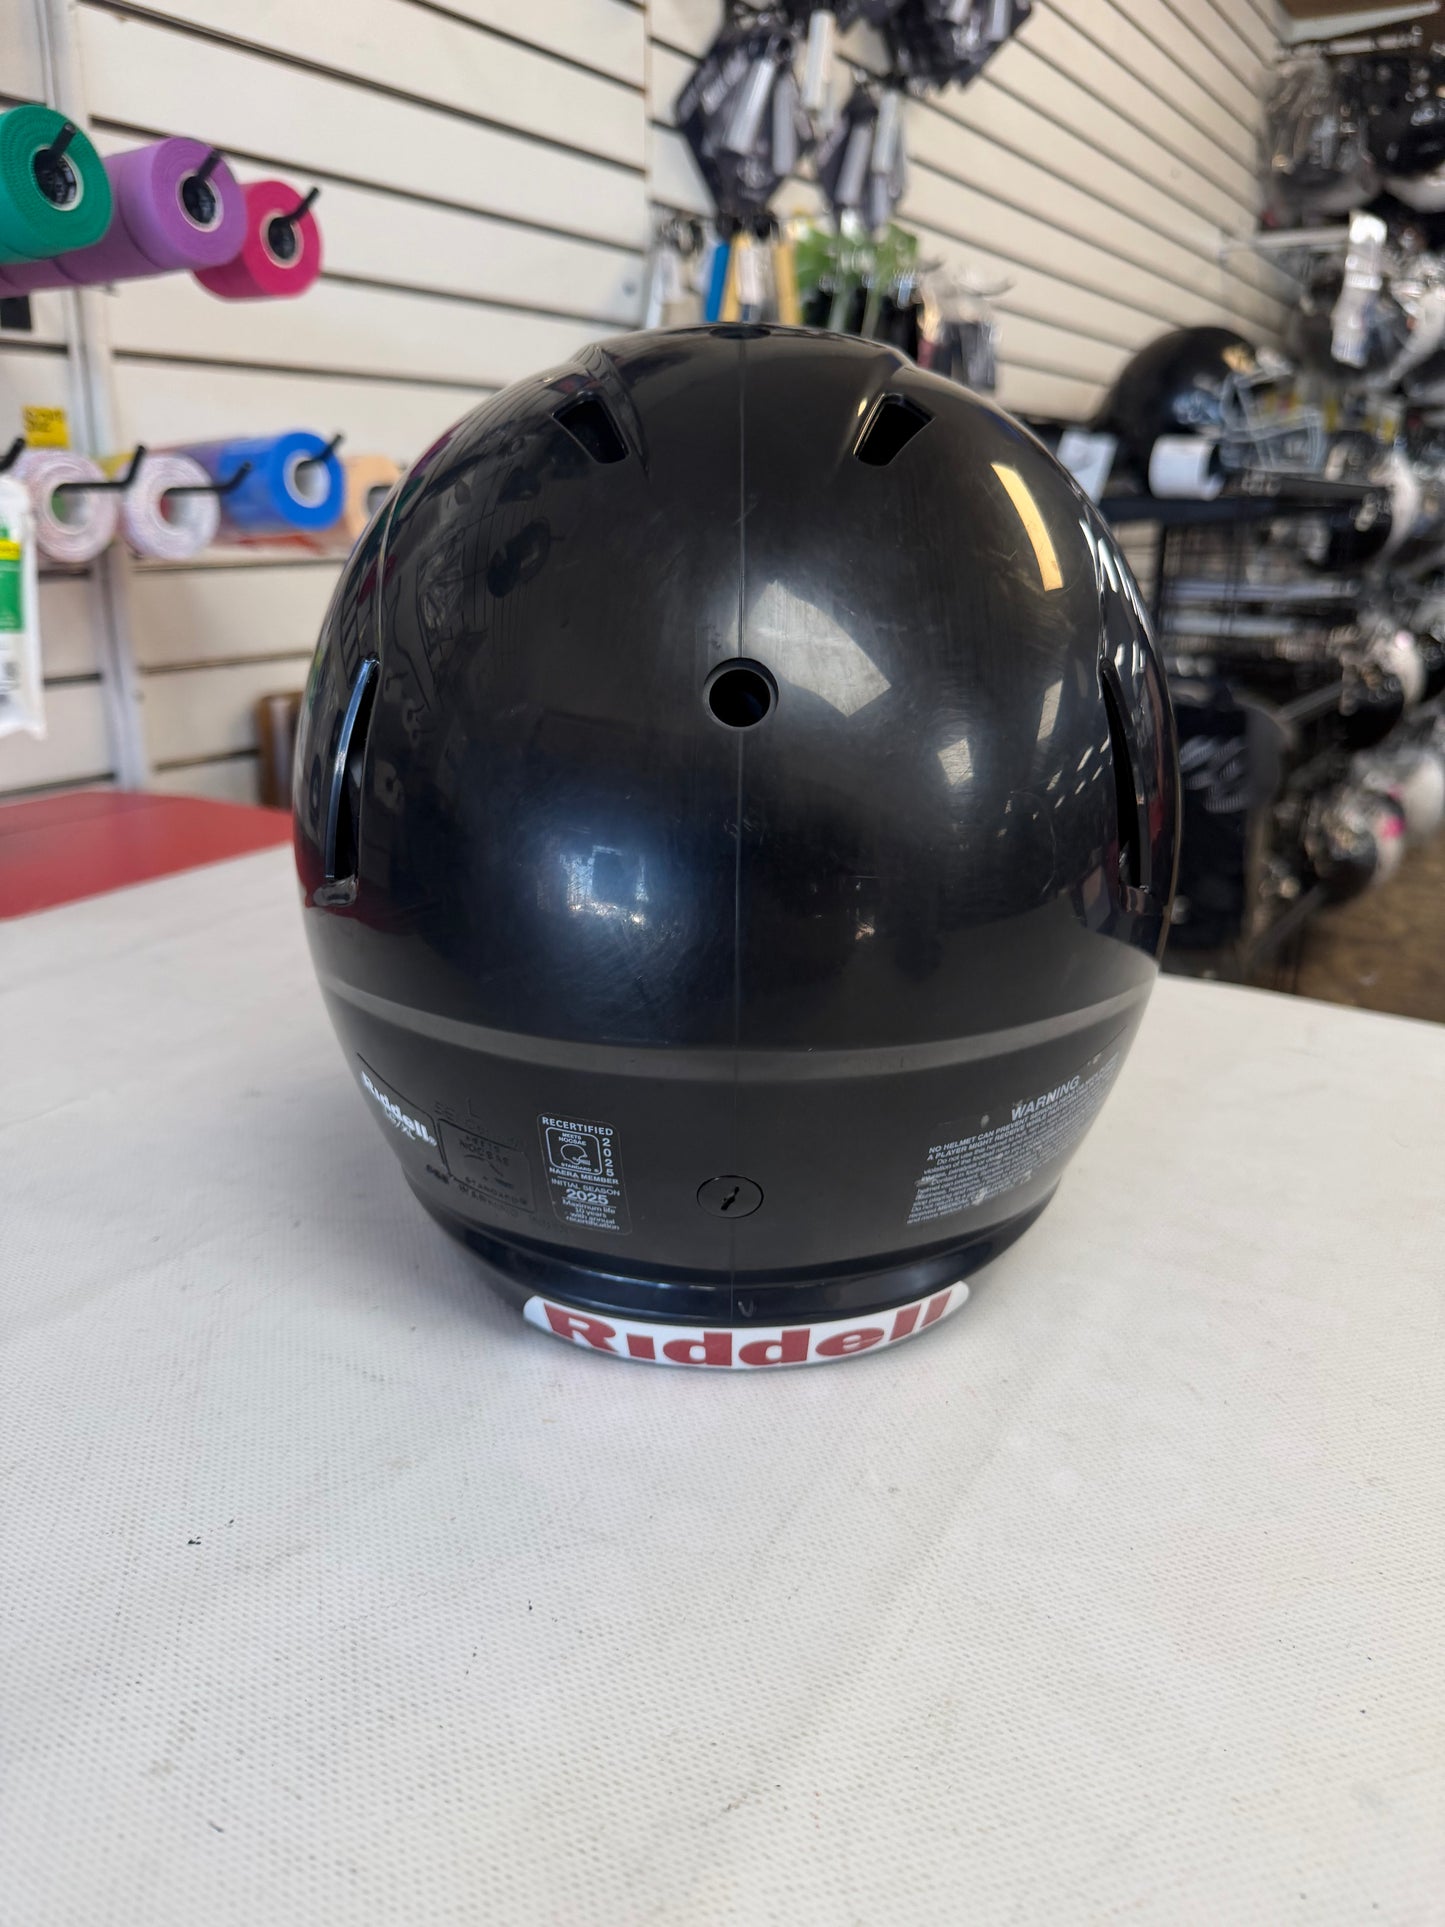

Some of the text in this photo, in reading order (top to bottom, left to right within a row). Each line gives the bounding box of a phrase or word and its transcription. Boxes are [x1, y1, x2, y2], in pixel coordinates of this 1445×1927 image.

[1011, 1075, 1080, 1121] WARNING
[541, 1116, 614, 1136] RECERTIFIED
[928, 1145, 942, 1154] NO
[943, 1136, 978, 1151] HELMET
[977, 1130, 995, 1141] CAN
[995, 1118, 1029, 1135] PREVENT
[558, 1136, 587, 1146] NOCSAE
[926, 1153, 934, 1161] A
[935, 1146, 968, 1159] PLAYER
[968, 1138, 994, 1151] MIGHT
[995, 1124, 1027, 1142] RECEIVE
[551, 1178, 621, 1197] INITIAL SEASON
[580, 1173, 620, 1185] MEMBER
[565, 1188, 609, 1206] 2025
[543, 1288, 953, 1367] Riddell
